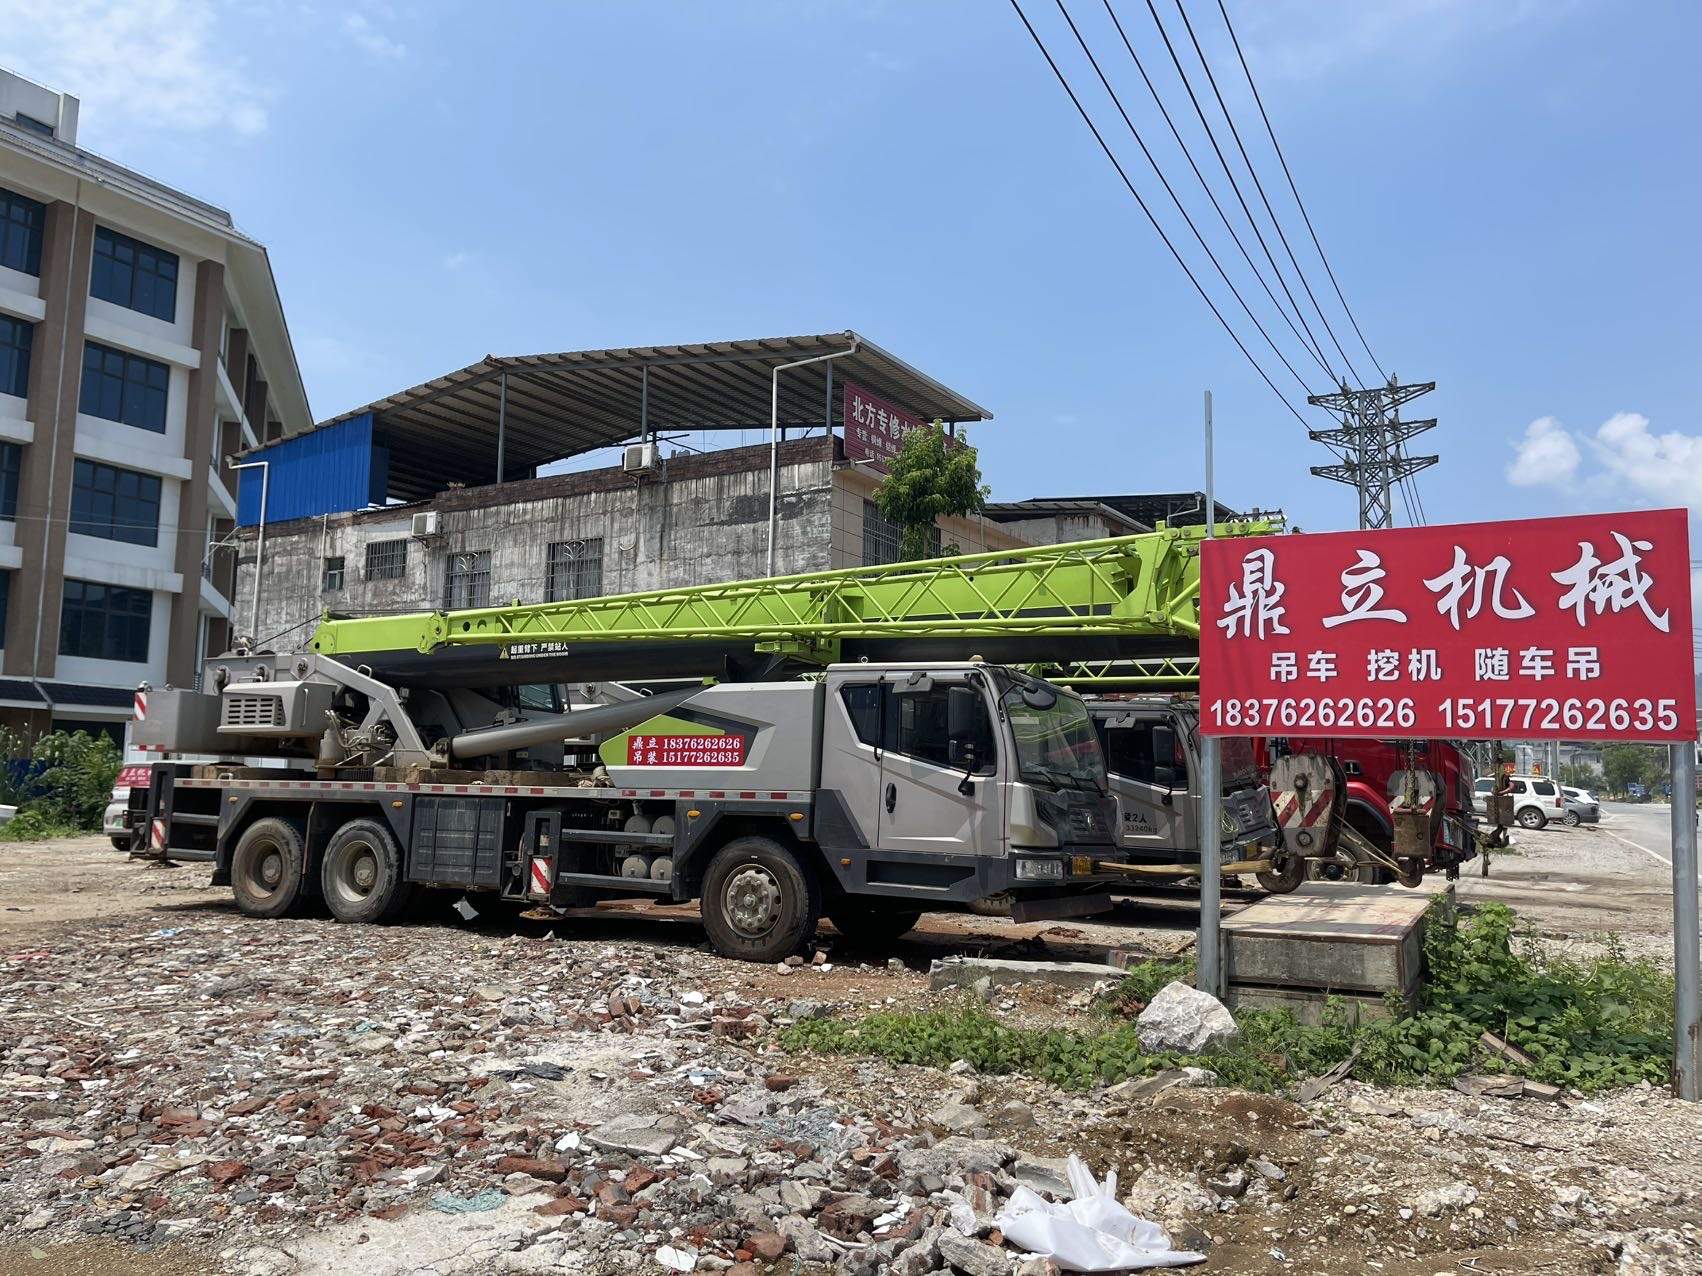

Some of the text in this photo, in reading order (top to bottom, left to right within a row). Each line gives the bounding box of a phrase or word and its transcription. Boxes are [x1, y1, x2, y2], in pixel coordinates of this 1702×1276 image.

[1216, 530, 1670, 641] 鼎立机械
[1270, 646, 1600, 683] 吊车 挖机 随车吊
[1210, 697, 1678, 731] 18376262626 15177262635
[632, 736, 741, 750] 鼎立 18376262626
[632, 750, 740, 765] 吊装 15177262635
